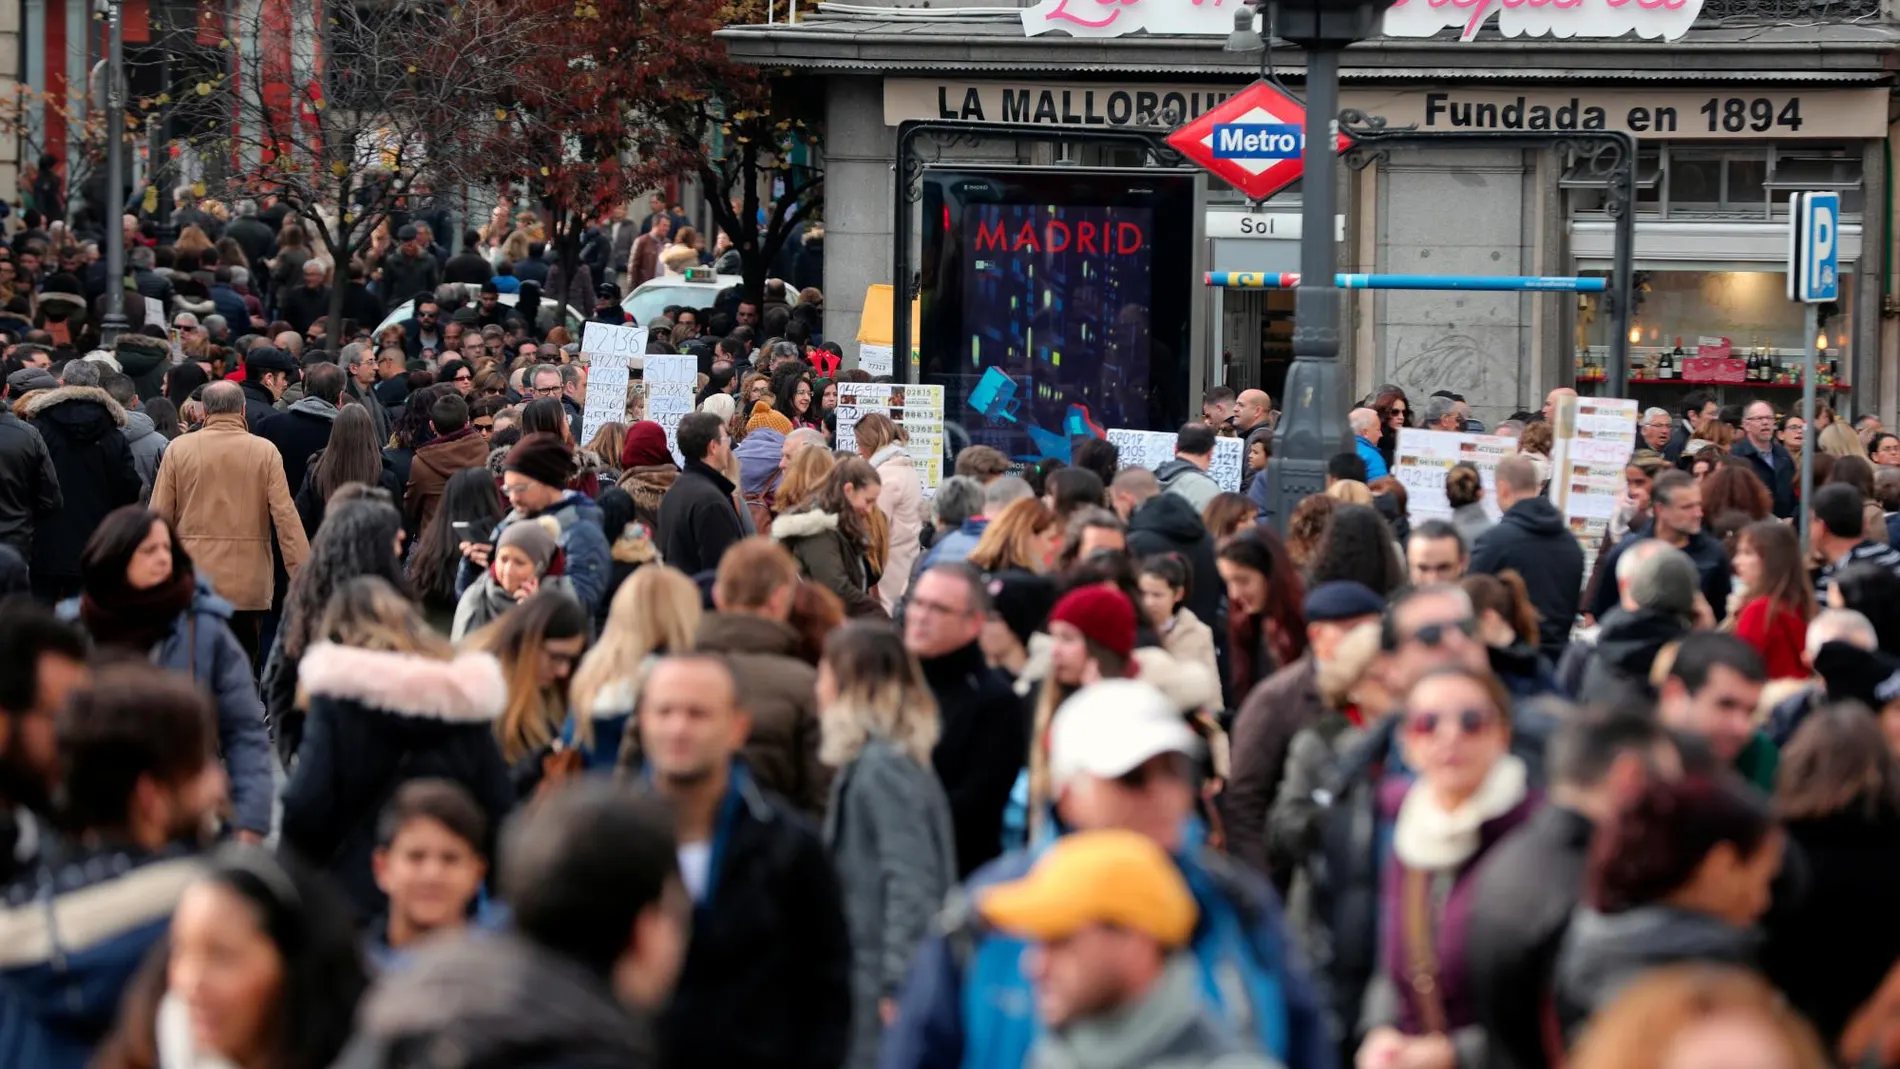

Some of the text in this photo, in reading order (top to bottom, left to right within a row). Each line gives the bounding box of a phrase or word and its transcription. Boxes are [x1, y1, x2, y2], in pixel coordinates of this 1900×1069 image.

[938, 86, 986, 121] LA
[1426, 93, 1802, 132] Fundada en 1894
[1220, 128, 1295, 152] Metro
[974, 219, 1143, 254] MADRID
[1240, 217, 1274, 234] Sol
[1811, 206, 1834, 289] P
